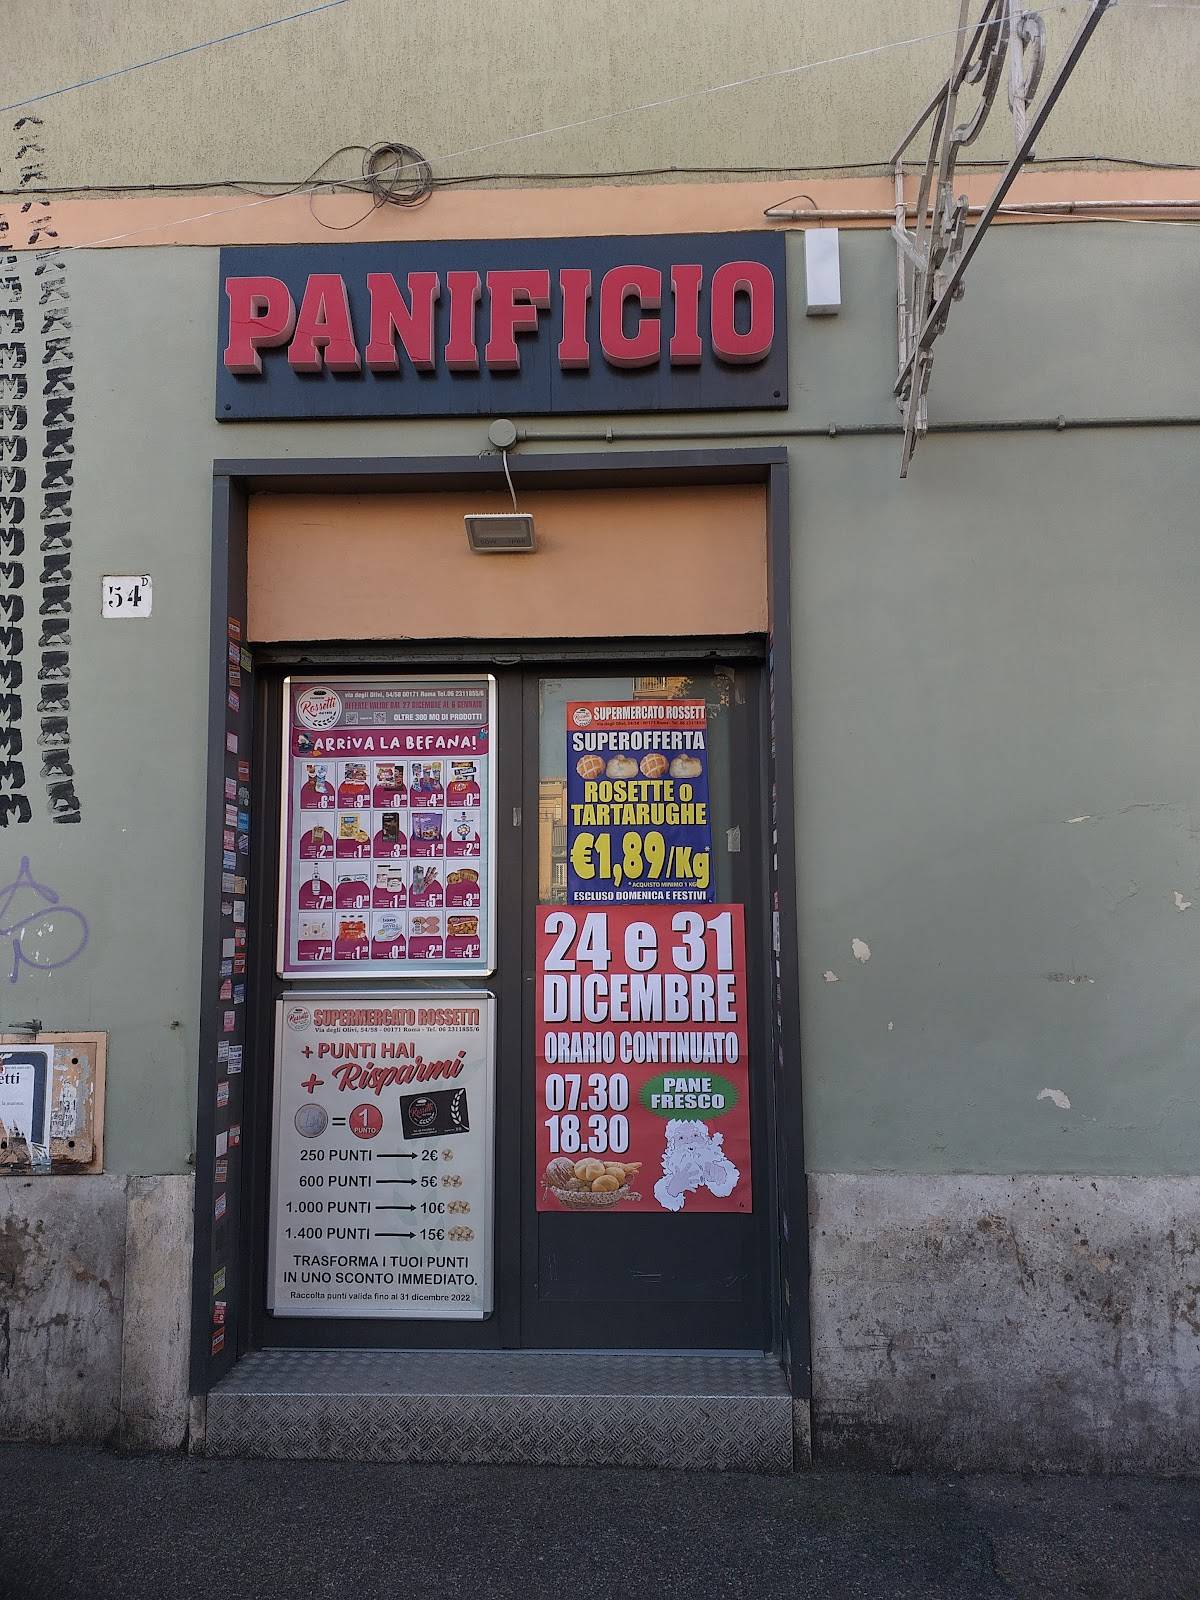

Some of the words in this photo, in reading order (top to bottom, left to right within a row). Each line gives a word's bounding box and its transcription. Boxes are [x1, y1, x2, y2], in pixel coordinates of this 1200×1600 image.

[223, 261, 775, 374] PANIFICIO
[108, 585, 141, 608] 54
[141, 577, 149, 587] D
[301, 697, 336, 717] Rossetti
[593, 706, 665, 720] SUPERMERCATO
[393, 713, 413, 721] OLTRE
[415, 713, 428, 721] 300
[429, 713, 440, 721] MQ
[441, 713, 449, 721] DI
[450, 713, 483, 721] PRODOTTI
[380, 736, 400, 750] LA
[406, 736, 477, 750] BEFANA!
[572, 731, 705, 751] SUPEROFFERTA
[584, 780, 674, 803] ROSETTE
[571, 803, 707, 826] TARTARUGHE
[574, 891, 614, 901] ESCLUSO
[616, 891, 665, 900] DOMENICA
[666, 891, 670, 900] E
[672, 890, 707, 900] FESTIVI
[544, 911, 612, 972] 24
[624, 920, 658, 972] e
[671, 911, 733, 972] 31
[543, 972, 737, 1023] DICEMBRE
[313, 1008, 416, 1026] SUPERMERCATO
[417, 1008, 480, 1026] ROSSETTI
[318, 1042, 376, 1059] PUNTI
[380, 1042, 416, 1059] HAI
[544, 1032, 615, 1064] ORARIO
[620, 1031, 739, 1064] CONTINUATO
[332, 1050, 466, 1096] Risparmi
[545, 1072, 629, 1112] 07.30
[663, 1077, 712, 1093] PANE
[651, 1094, 725, 1110] FRESCO
[359, 1108, 369, 1127] 1
[544, 1114, 629, 1153] 18.30
[300, 1150, 325, 1161] 250
[329, 1150, 372, 1161] PUNTI
[421, 1150, 438, 1161] 2€
[299, 1176, 324, 1187] 600
[328, 1175, 372, 1187] PUNTI
[420, 1176, 438, 1187] 5€
[286, 1201, 323, 1213] 1.000
[327, 1201, 371, 1213] PUNTI
[420, 1202, 445, 1214] 10€
[285, 1228, 322, 1239] 1.400
[327, 1228, 370, 1239] PUNTI
[419, 1228, 445, 1240] 15€
[293, 1255, 378, 1267] TRASFORMA
[382, 1256, 386, 1267] I
[390, 1256, 423, 1267] TUOI
[427, 1256, 469, 1268] PUNTI
[283, 1272, 297, 1283] IN
[301, 1272, 331, 1283] UNO
[335, 1272, 394, 1284] SCONTO
[397, 1273, 478, 1286] IMMEDIATO.
[290, 1291, 325, 1299] Raccolta
[326, 1292, 347, 1300] punti
[348, 1292, 372, 1300] valida
[374, 1292, 389, 1300] fino
[390, 1292, 398, 1300] al
[411, 1293, 450, 1301] dicembre
[450, 1294, 471, 1302] 2022
